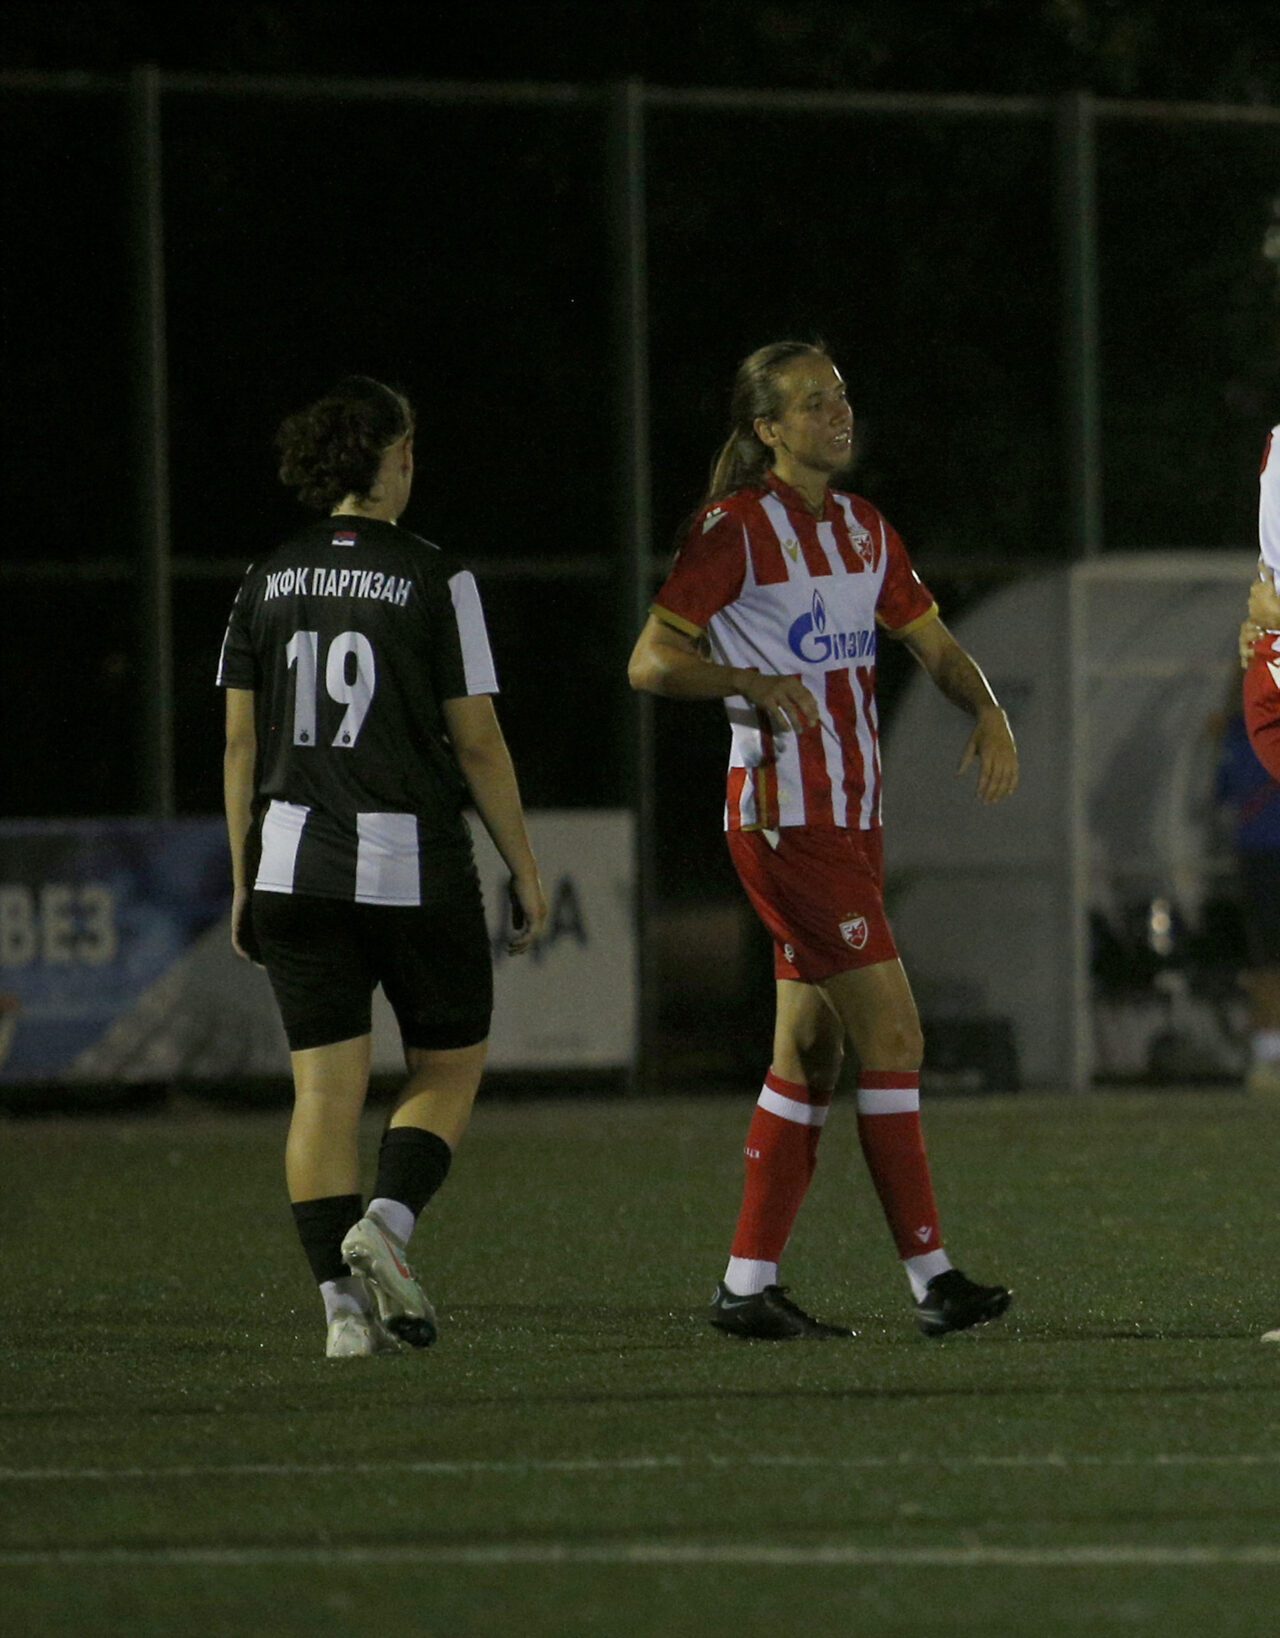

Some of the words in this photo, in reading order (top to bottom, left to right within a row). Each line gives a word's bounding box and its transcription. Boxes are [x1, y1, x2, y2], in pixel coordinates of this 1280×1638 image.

[264, 567, 310, 601] ЖФК
[312, 568, 413, 607] ПАРТИЗАН
[286, 630, 376, 748] 19
